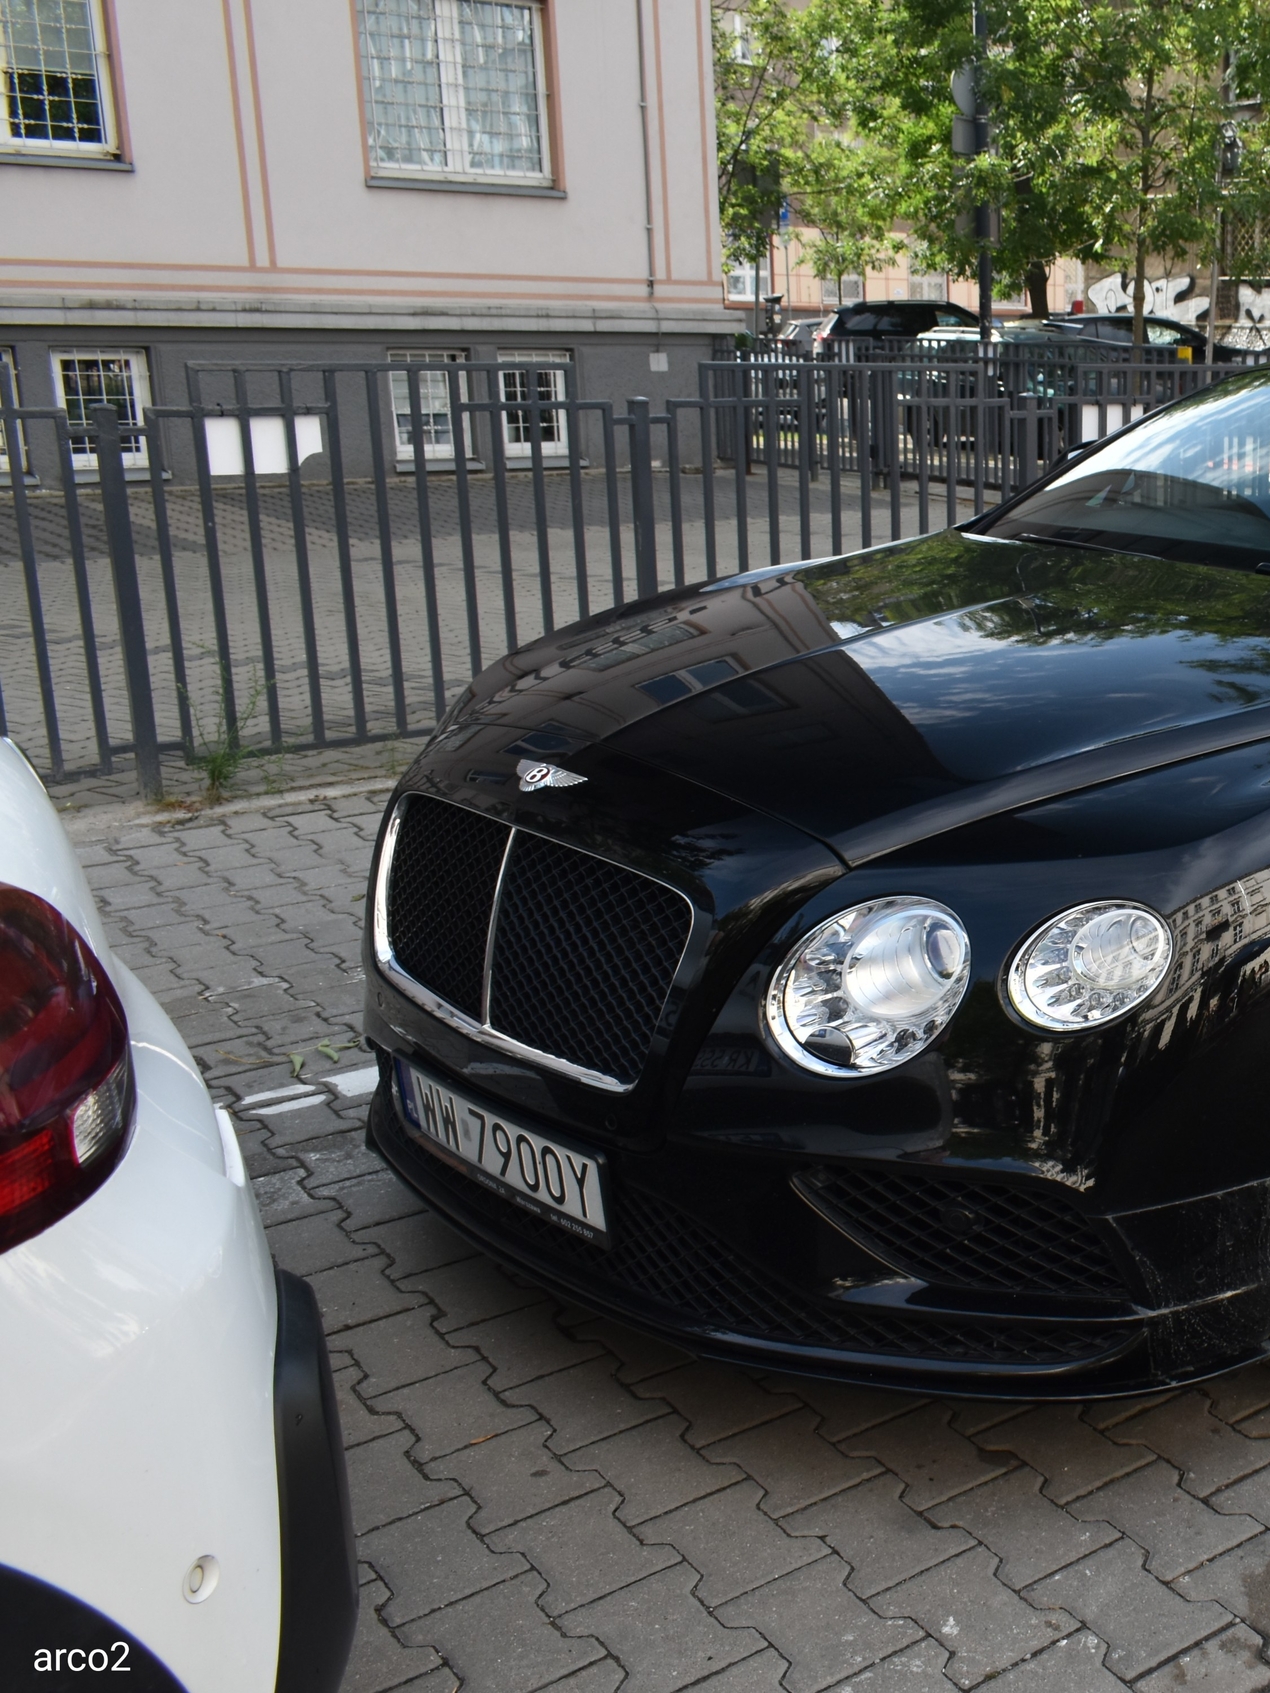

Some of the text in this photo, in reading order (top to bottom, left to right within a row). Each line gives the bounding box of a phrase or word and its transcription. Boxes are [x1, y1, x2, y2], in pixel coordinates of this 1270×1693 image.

[406, 1098, 418, 1118] PL
[416, 1075, 589, 1220] WW 7900Y
